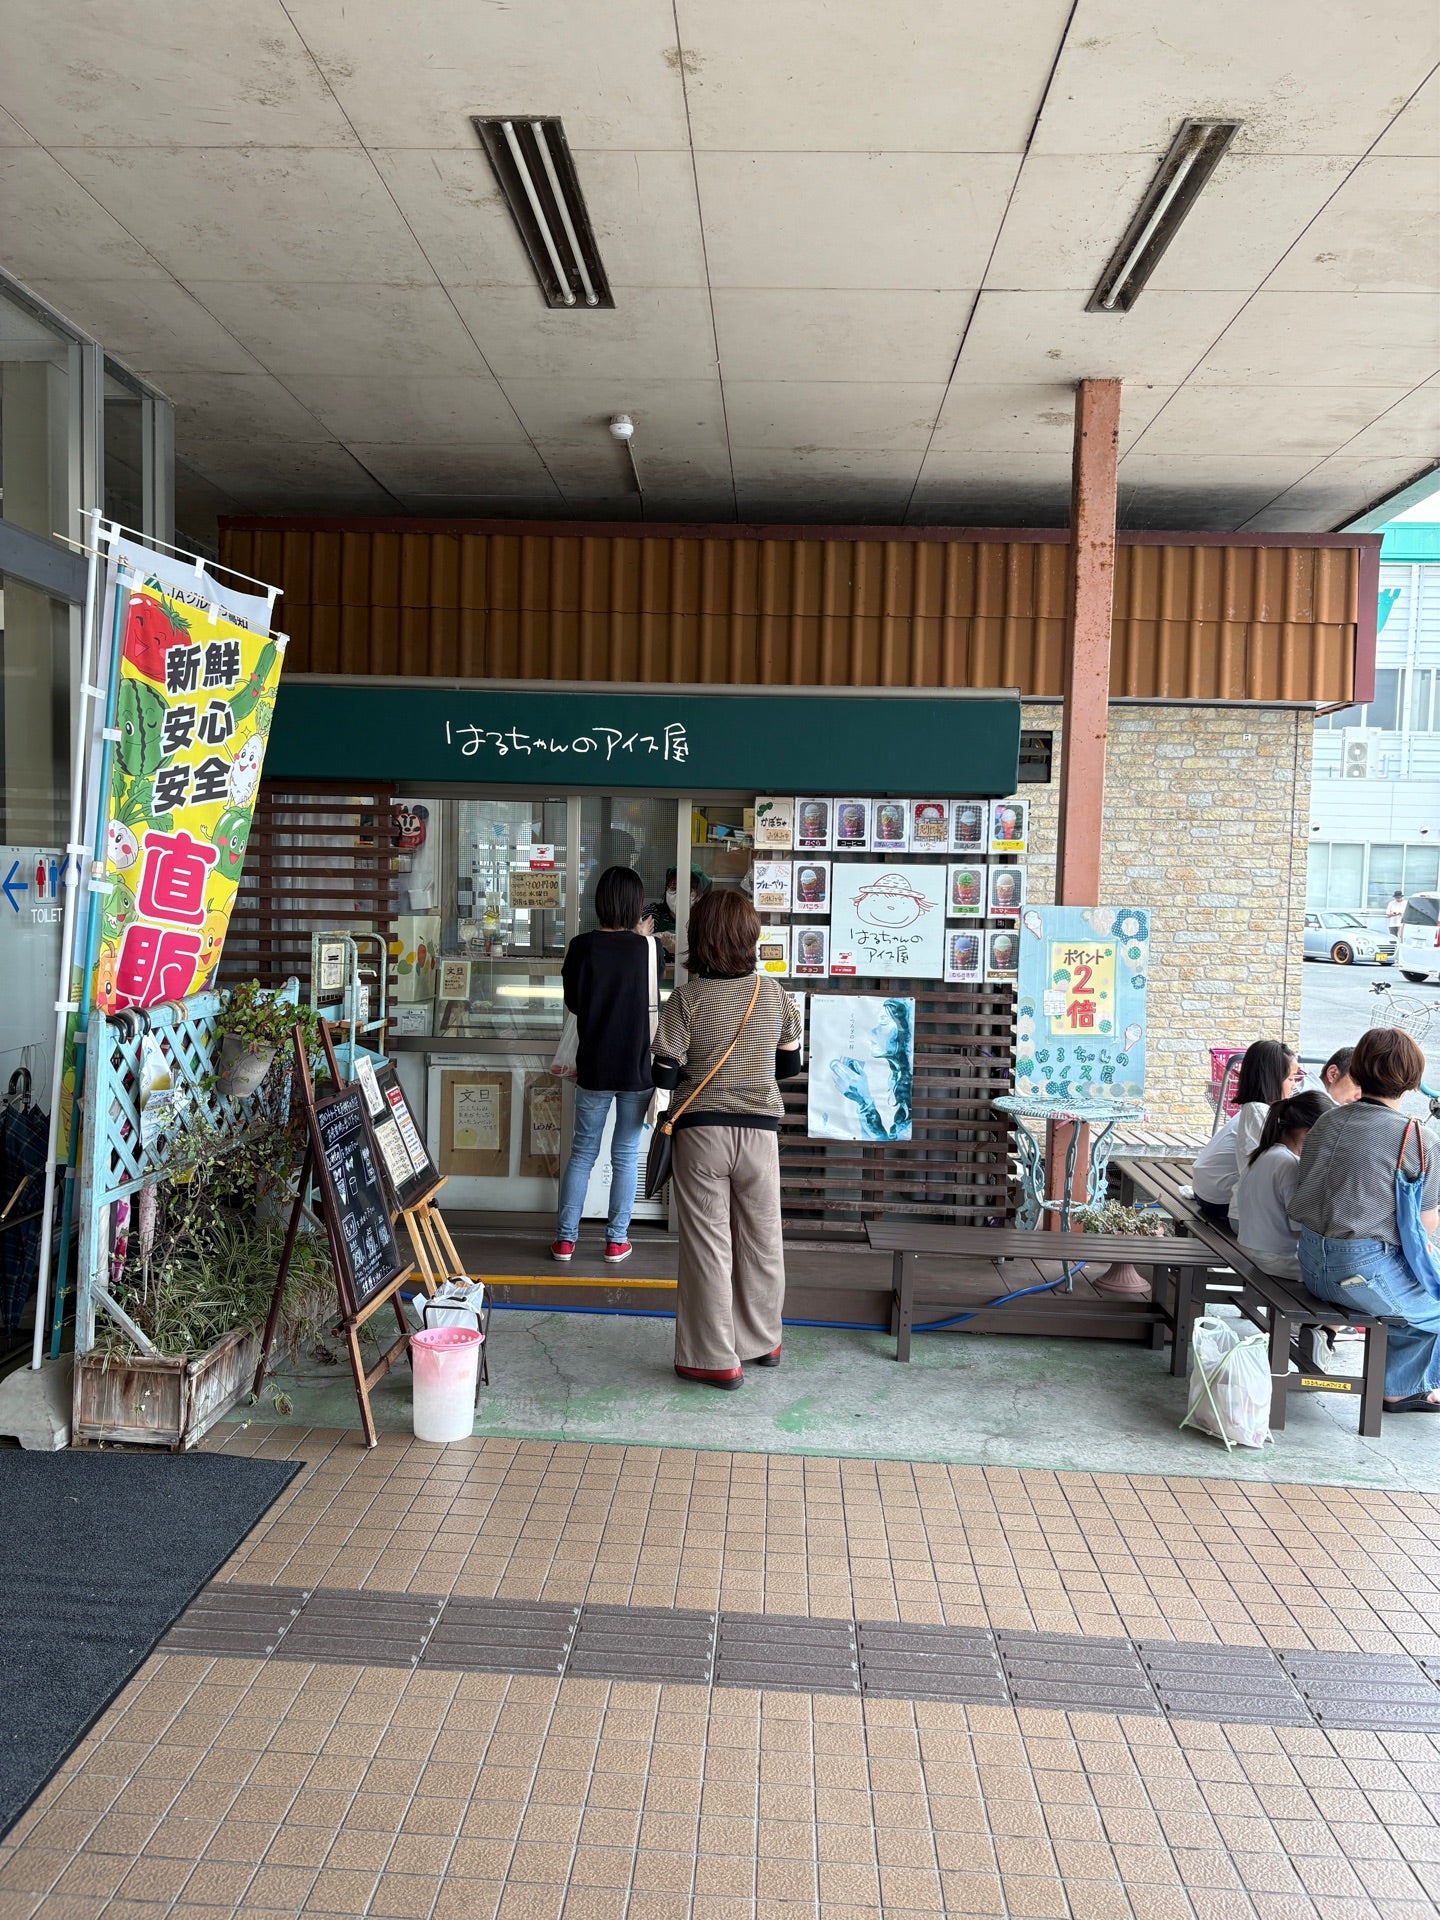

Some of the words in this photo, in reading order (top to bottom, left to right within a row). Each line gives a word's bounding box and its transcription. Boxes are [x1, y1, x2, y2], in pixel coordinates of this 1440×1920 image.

[167, 641, 240, 692] 新鮮
[162, 702, 232, 751] 安心
[446, 721, 688, 762] はるちゃんのアイス屋
[154, 759, 230, 812] 安全
[761, 816, 787, 827] かぼちゃ
[756, 881, 788, 890] ブルーベリー
[31, 908, 62, 923] TOILET
[116, 834, 217, 1009] 直販
[850, 928, 923, 945] はるちゃんの
[863, 945, 909, 964] アイス屋
[1064, 949, 1104, 965] ポイント
[1072, 965, 1094, 994] 2
[1067, 1000, 1096, 1028] 倍
[1036, 1047, 1129, 1066] はるちゃんの
[1042, 1066, 1115, 1084] アイス屋
[459, 1088, 492, 1103] 文旦
